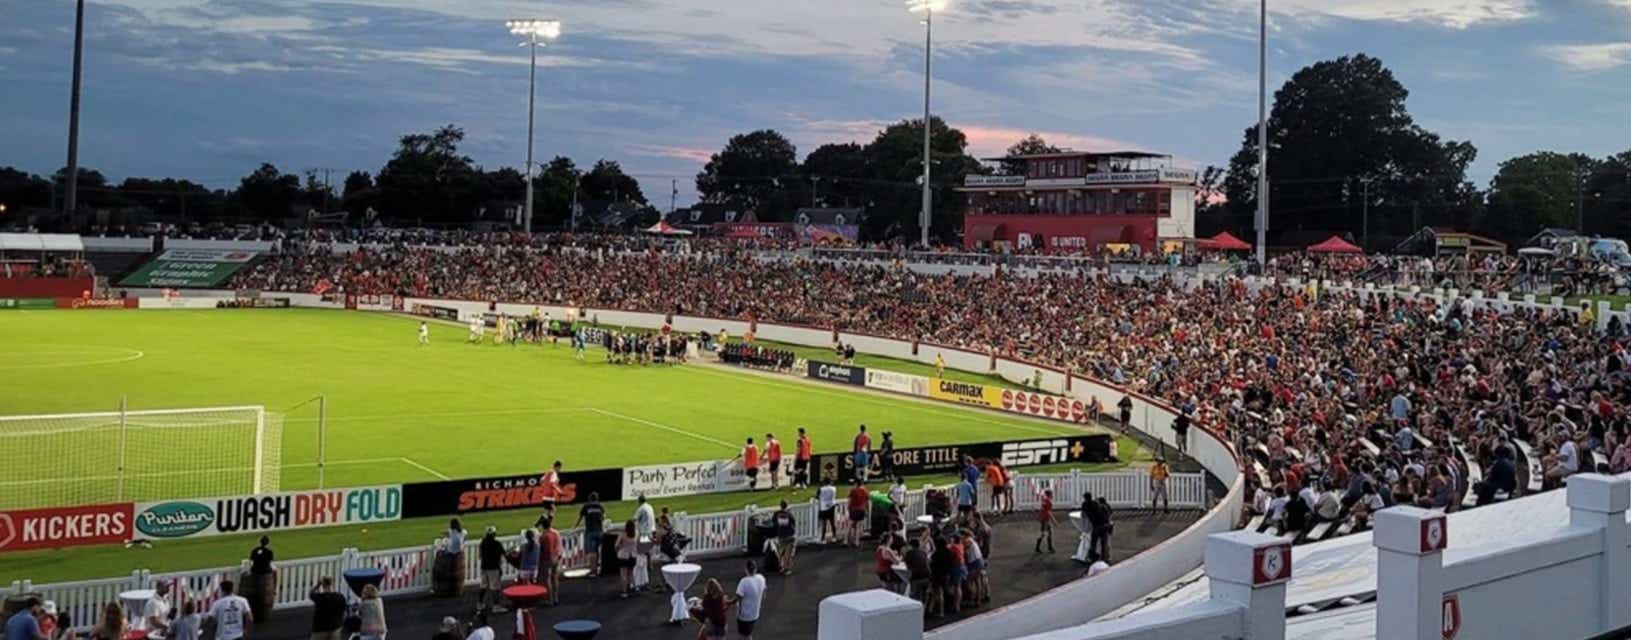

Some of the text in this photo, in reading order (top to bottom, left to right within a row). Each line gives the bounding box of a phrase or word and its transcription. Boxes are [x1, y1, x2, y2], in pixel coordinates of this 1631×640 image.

[1060, 236, 1087, 247] UNITED
[844, 447, 959, 469] SAORE TITLE
[629, 464, 716, 485] Party Perfect
[475, 478, 541, 490] RICHMO
[663, 485, 686, 494] Event
[458, 483, 577, 510] STRIKES
[142, 510, 215, 526] Puritan
[216, 488, 400, 533] WASH DRY FOLD
[23, 511, 126, 542] KICKERS
[1267, 554, 1278, 569] K
